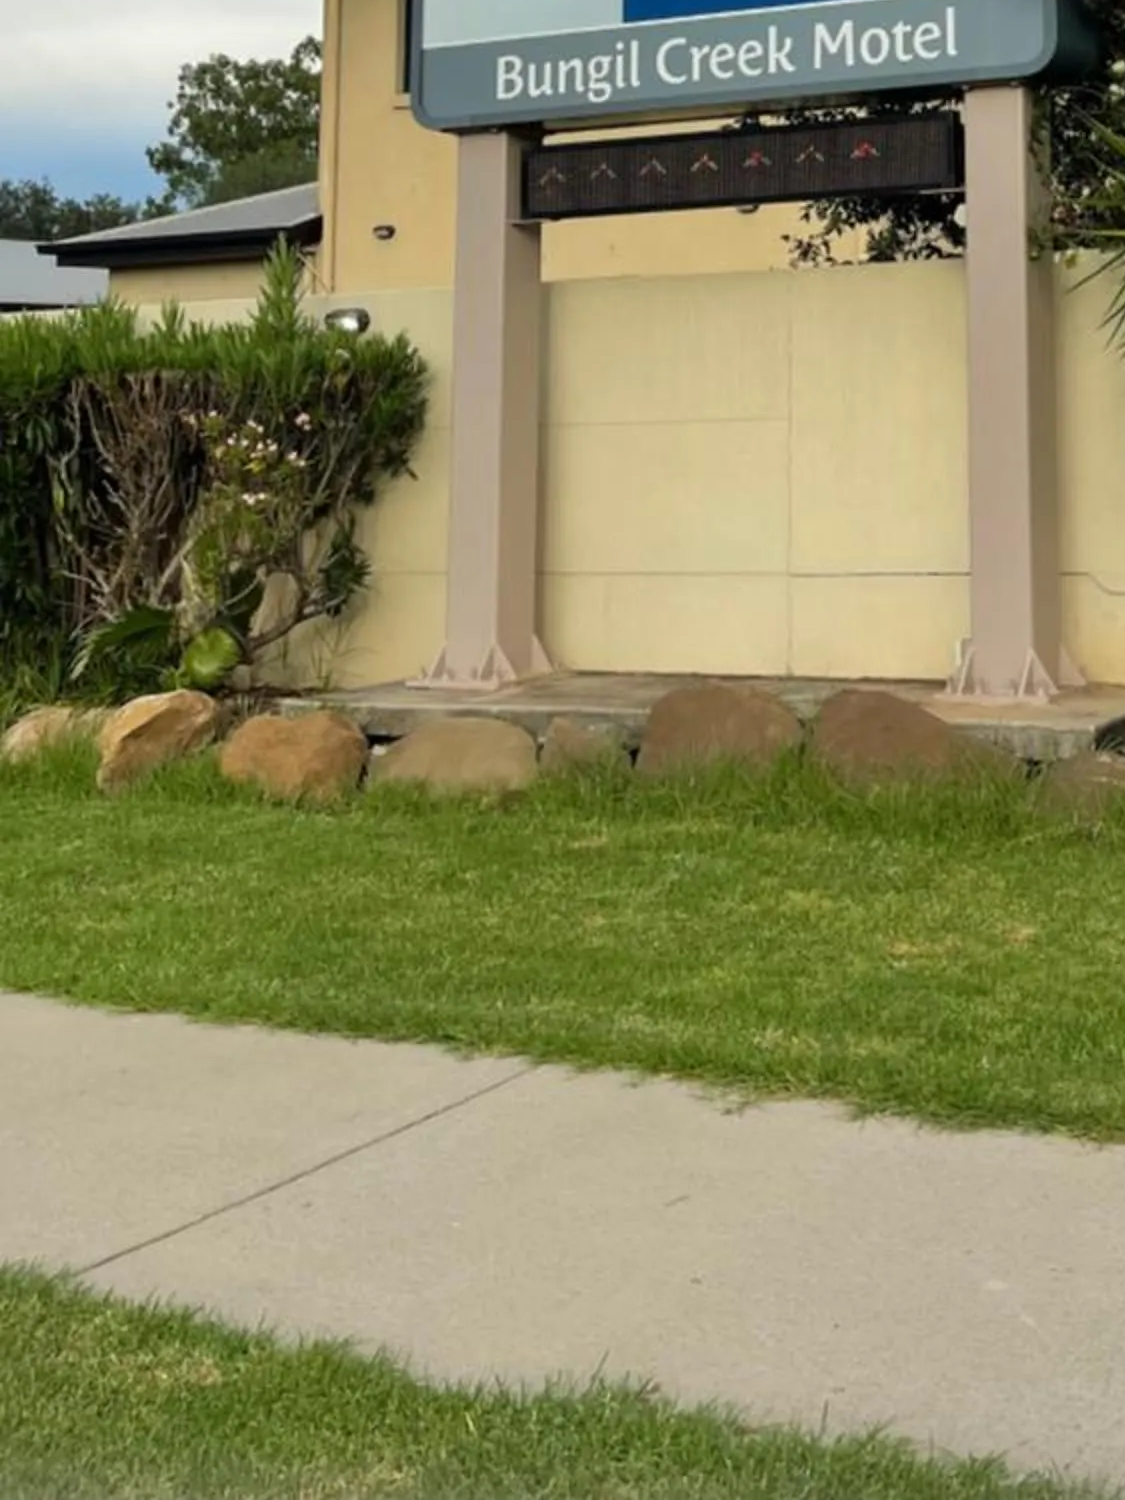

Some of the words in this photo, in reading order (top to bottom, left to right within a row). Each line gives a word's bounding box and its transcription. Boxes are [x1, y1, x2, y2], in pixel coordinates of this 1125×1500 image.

[495, 40, 642, 104] Bungil
[655, 24, 798, 85] Creek
[812, 5, 959, 70] Motel
